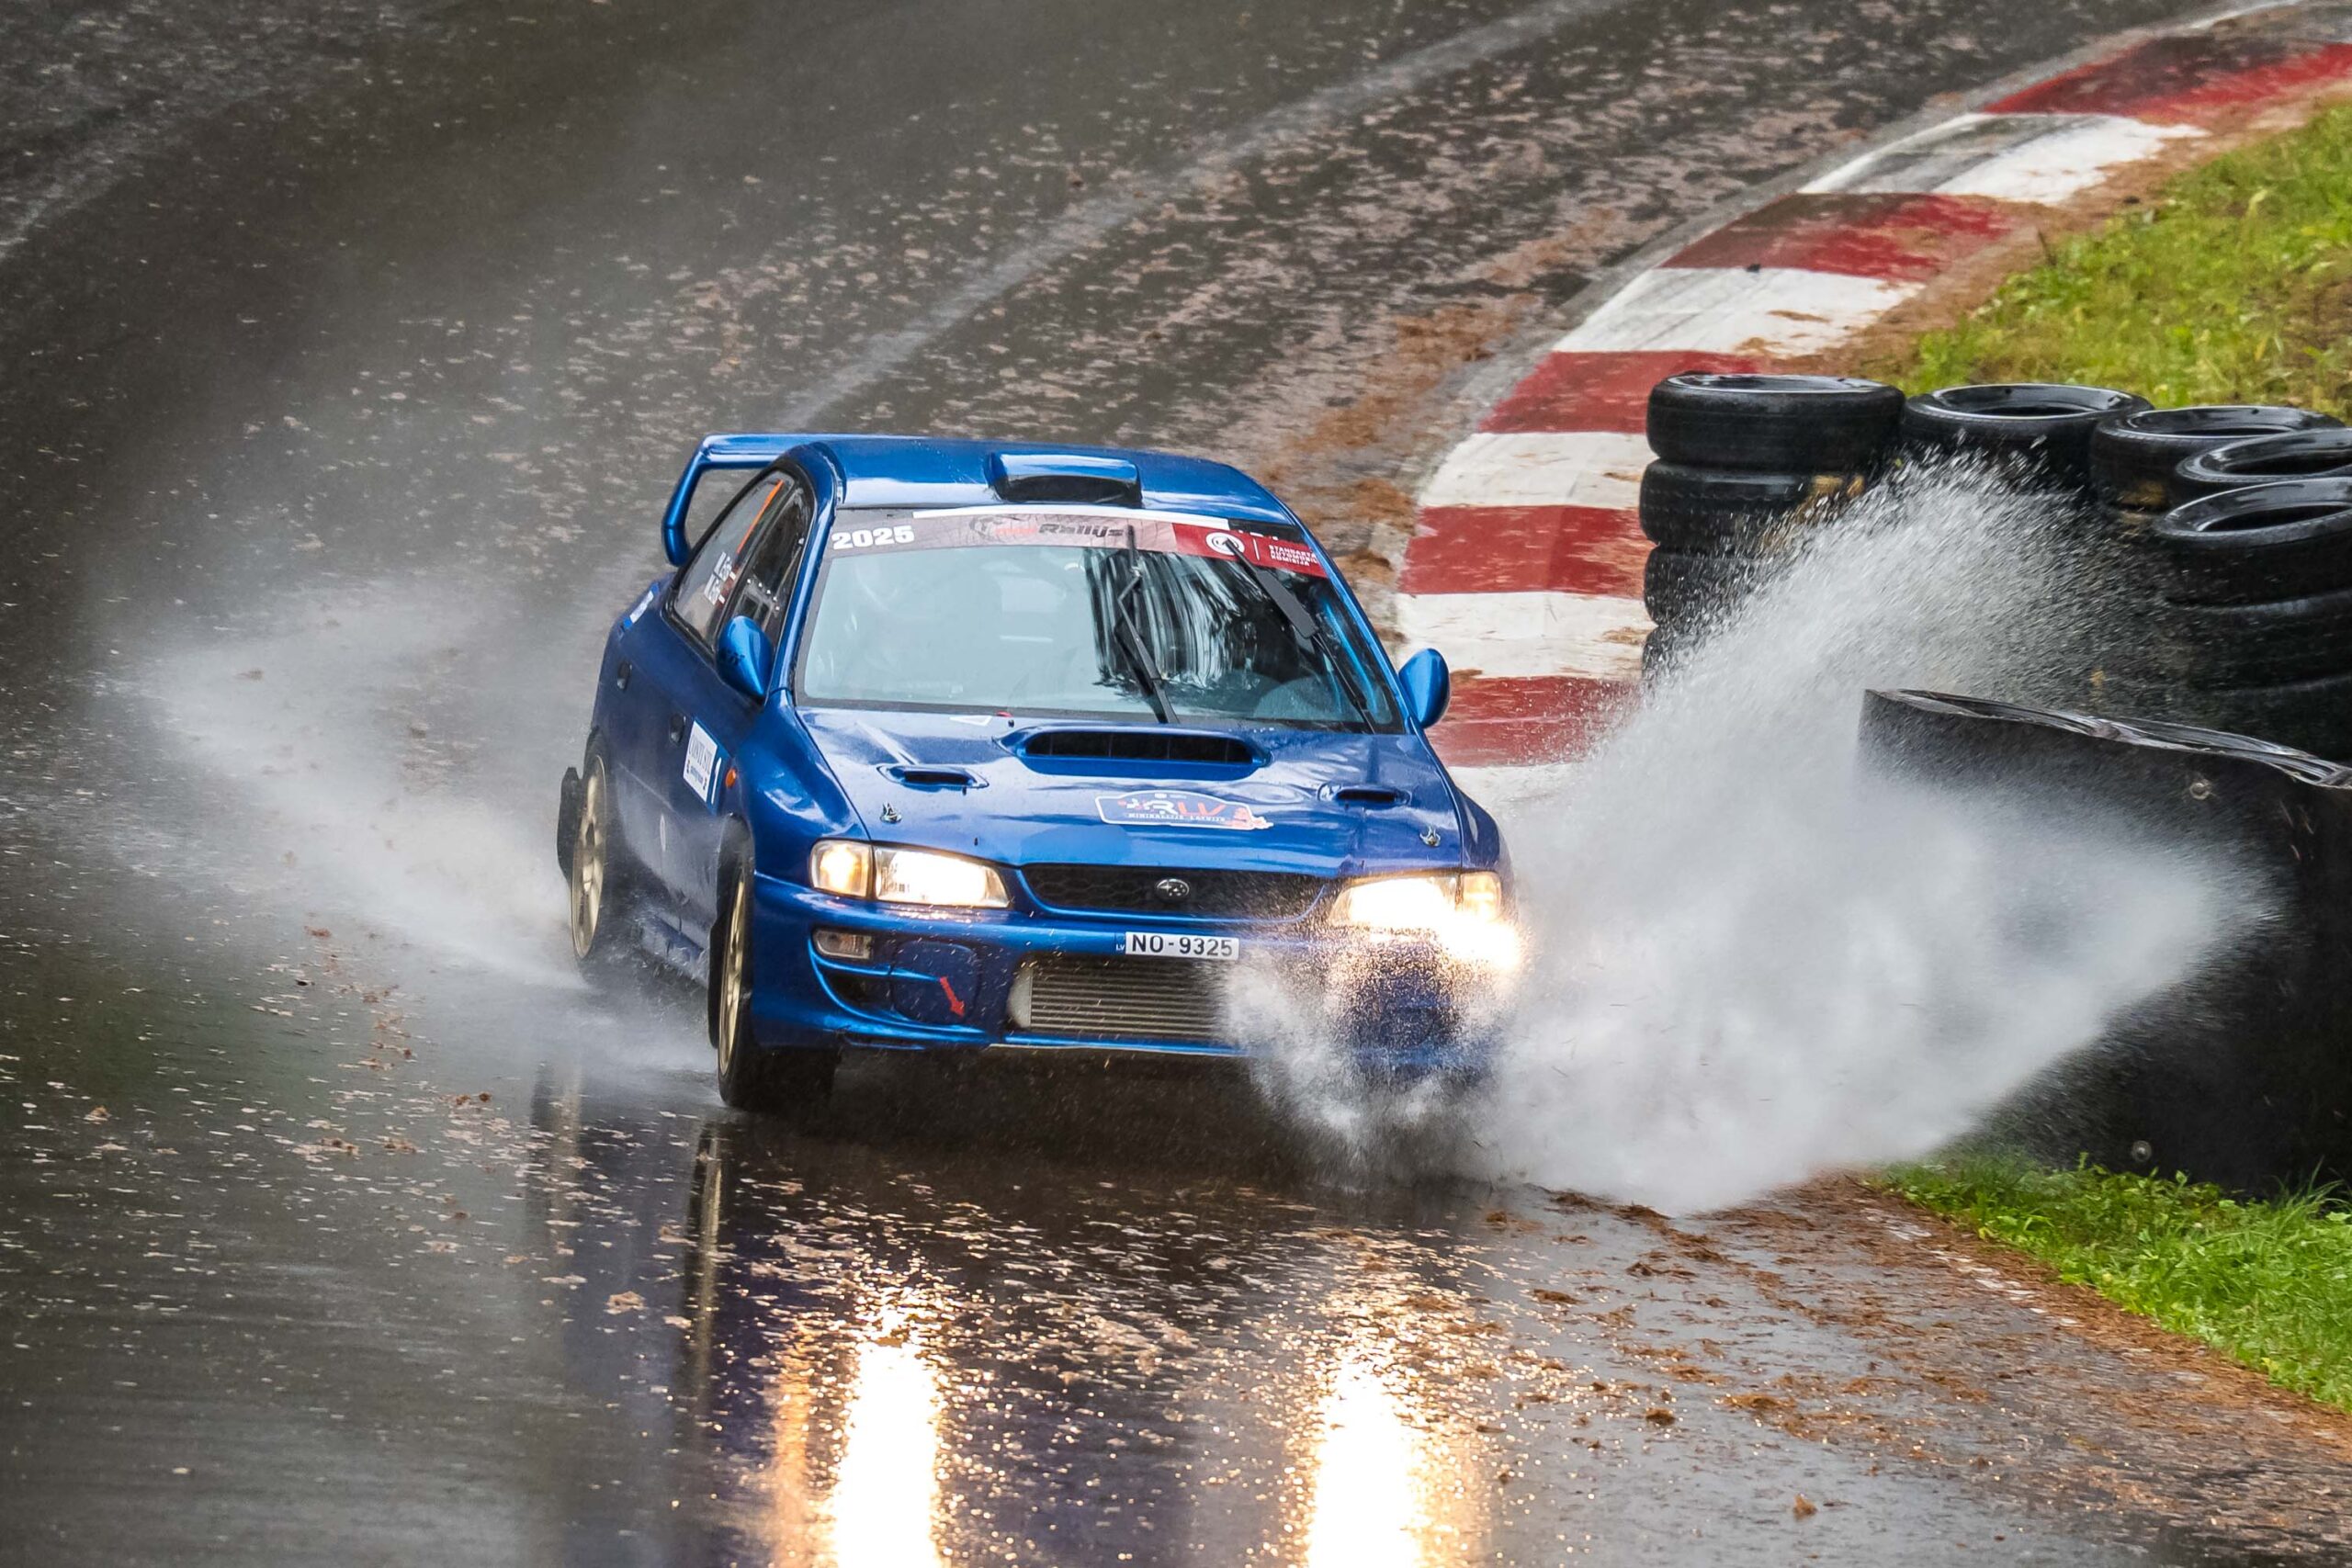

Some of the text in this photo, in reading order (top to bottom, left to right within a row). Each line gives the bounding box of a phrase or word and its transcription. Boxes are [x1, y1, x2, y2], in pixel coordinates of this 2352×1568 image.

[831, 525, 914, 549] 2025
[1038, 523, 1124, 537] Rallys
[1115, 933, 1233, 957] LV NO-9325
